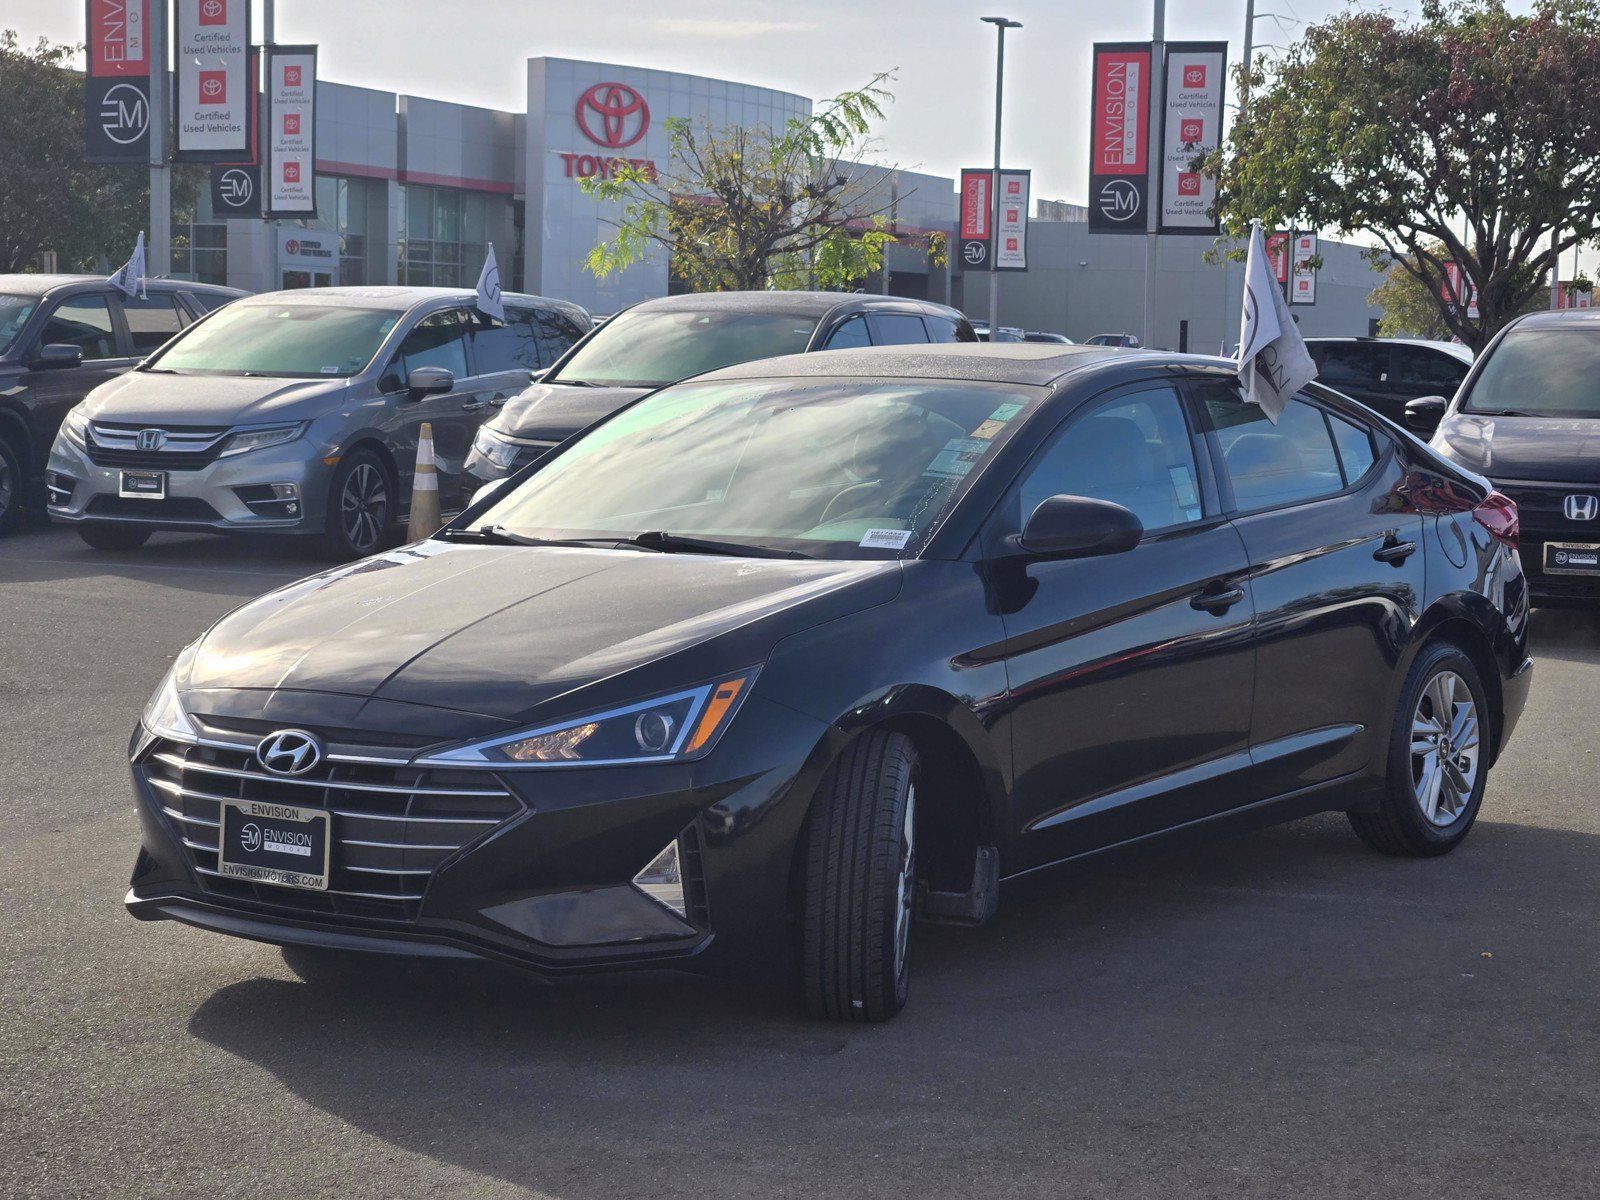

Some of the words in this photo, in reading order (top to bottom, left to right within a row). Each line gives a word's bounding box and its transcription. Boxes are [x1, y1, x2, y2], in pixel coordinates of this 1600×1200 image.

[194, 33, 231, 42] Certified
[183, 46, 205, 54] Used
[206, 45, 241, 54] Vehicles
[194, 112, 231, 121] Certified
[1104, 62, 1126, 165] ENVISION
[1127, 71, 1136, 156] MOTORS
[183, 125, 205, 133] Used
[206, 124, 241, 132] Vehicles
[966, 179, 978, 235] ENVISION
[251, 803, 299, 820] ENVISION
[264, 828, 312, 847] ENVISION
[223, 864, 323, 887] ENVISIONMOTORS.COM
